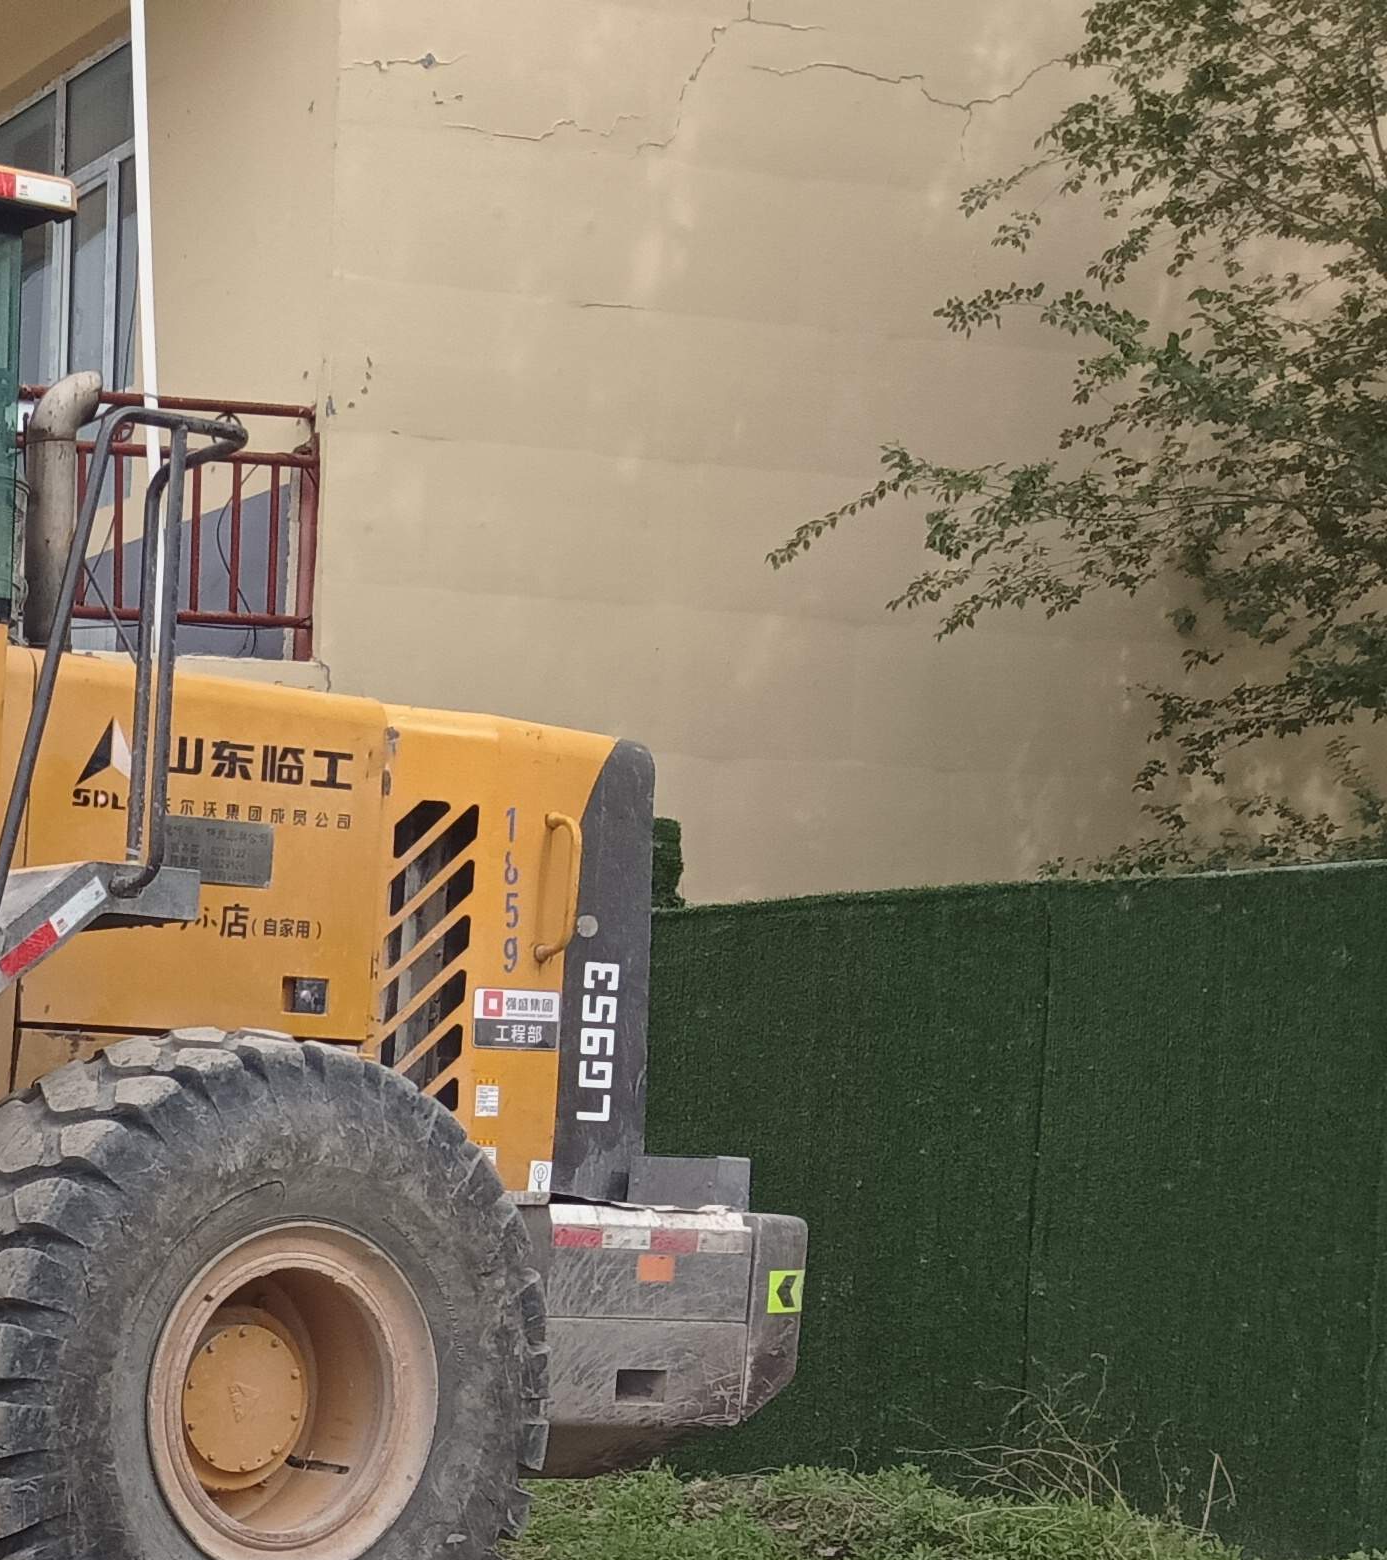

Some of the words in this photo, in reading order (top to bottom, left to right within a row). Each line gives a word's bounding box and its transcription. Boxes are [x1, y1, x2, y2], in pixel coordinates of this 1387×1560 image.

[167, 736, 355, 791] 山东临工
[495, 1024, 543, 1044] 工程部
[576, 961, 620, 1122] LG953
